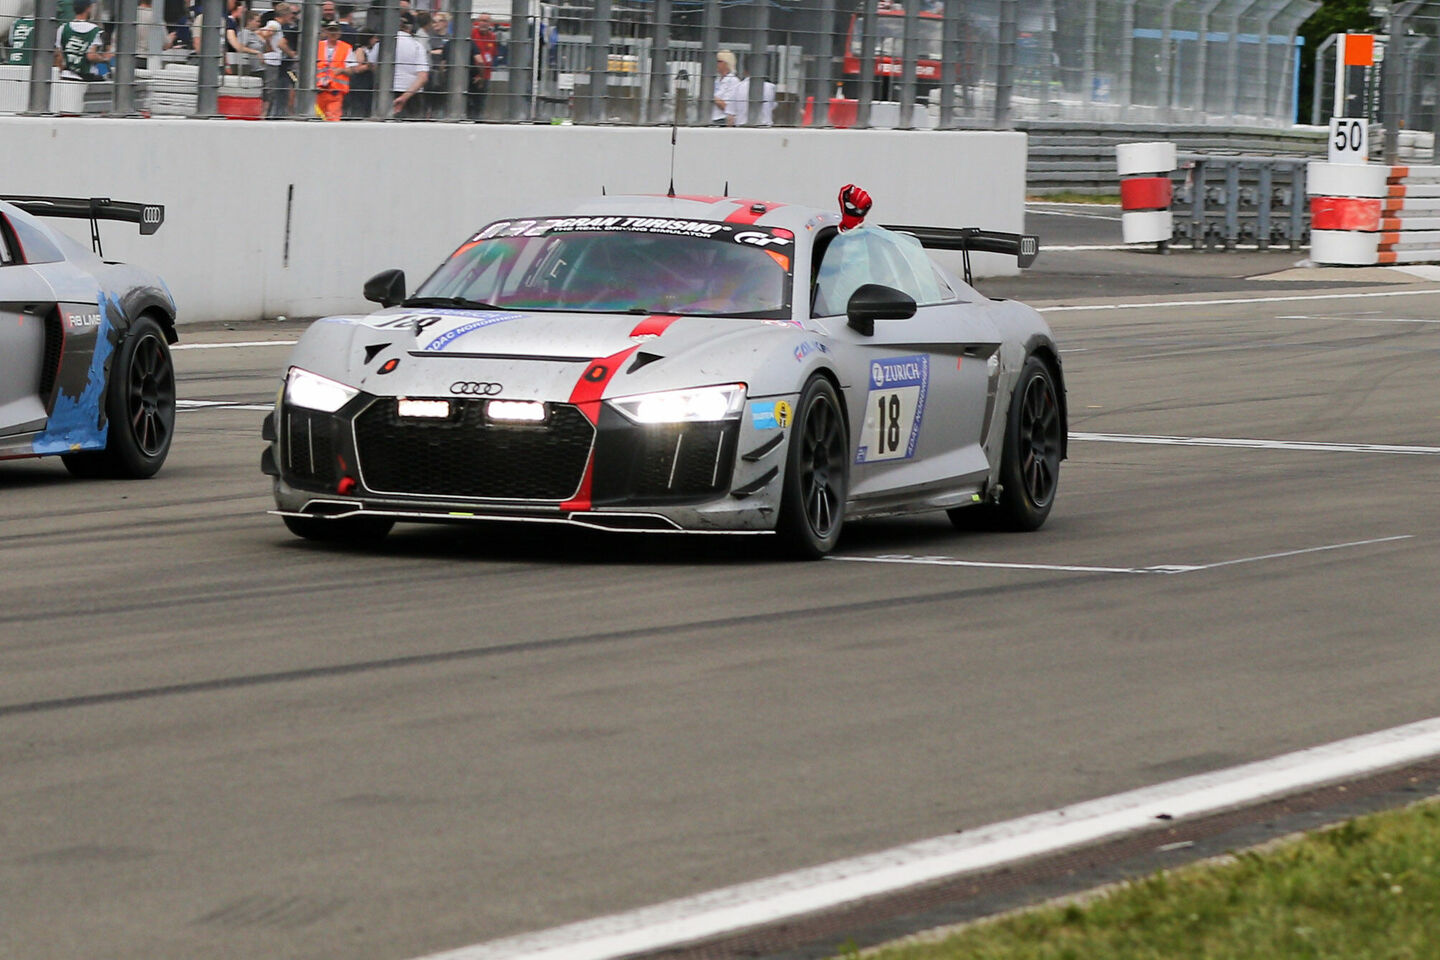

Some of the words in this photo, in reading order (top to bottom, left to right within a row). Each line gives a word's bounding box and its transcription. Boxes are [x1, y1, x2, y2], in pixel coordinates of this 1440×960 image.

[1335, 121, 1362, 152] 50
[560, 218, 622, 228] GRAN
[649, 228, 712, 238] SIMULATOR
[884, 363, 920, 382] ZURICH
[878, 394, 900, 454] 18
